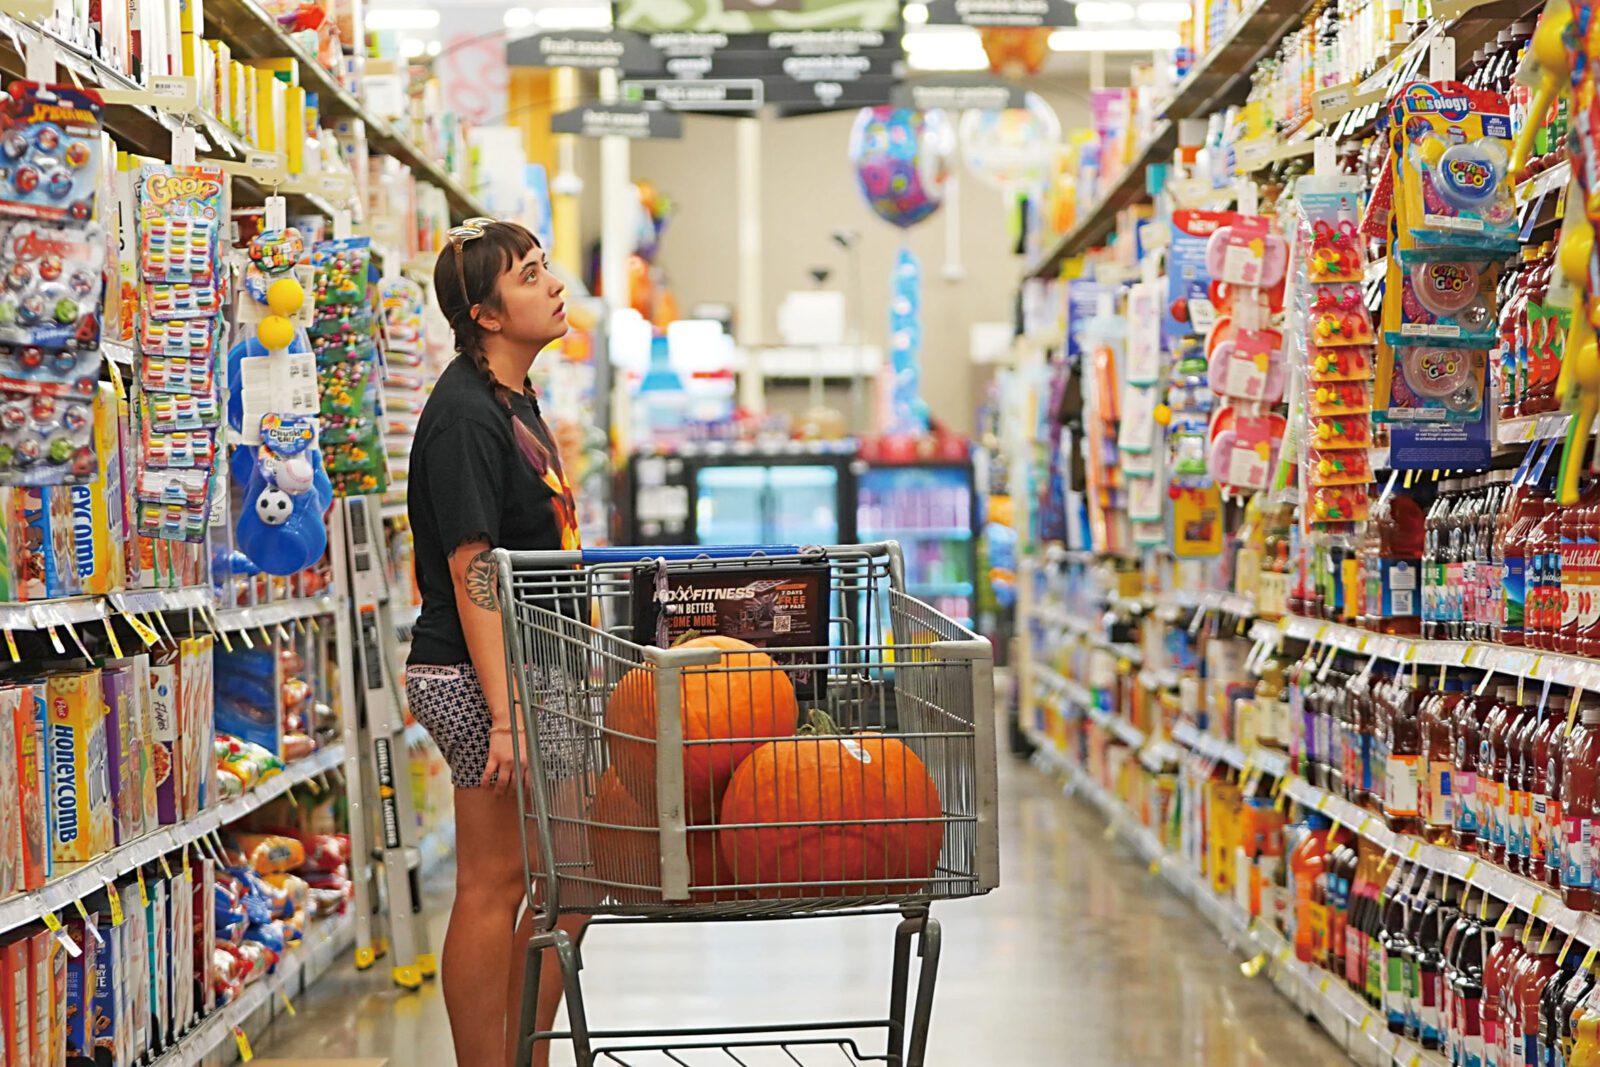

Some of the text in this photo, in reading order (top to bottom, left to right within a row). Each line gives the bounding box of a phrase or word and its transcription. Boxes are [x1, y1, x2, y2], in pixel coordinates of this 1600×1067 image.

[1435, 276, 1464, 292] GOO
[778, 595, 807, 604] FREE
[685, 602, 717, 614] BETTER.
[693, 615, 719, 627] MORE.
[377, 740, 397, 847] GORILLA LADDERS
